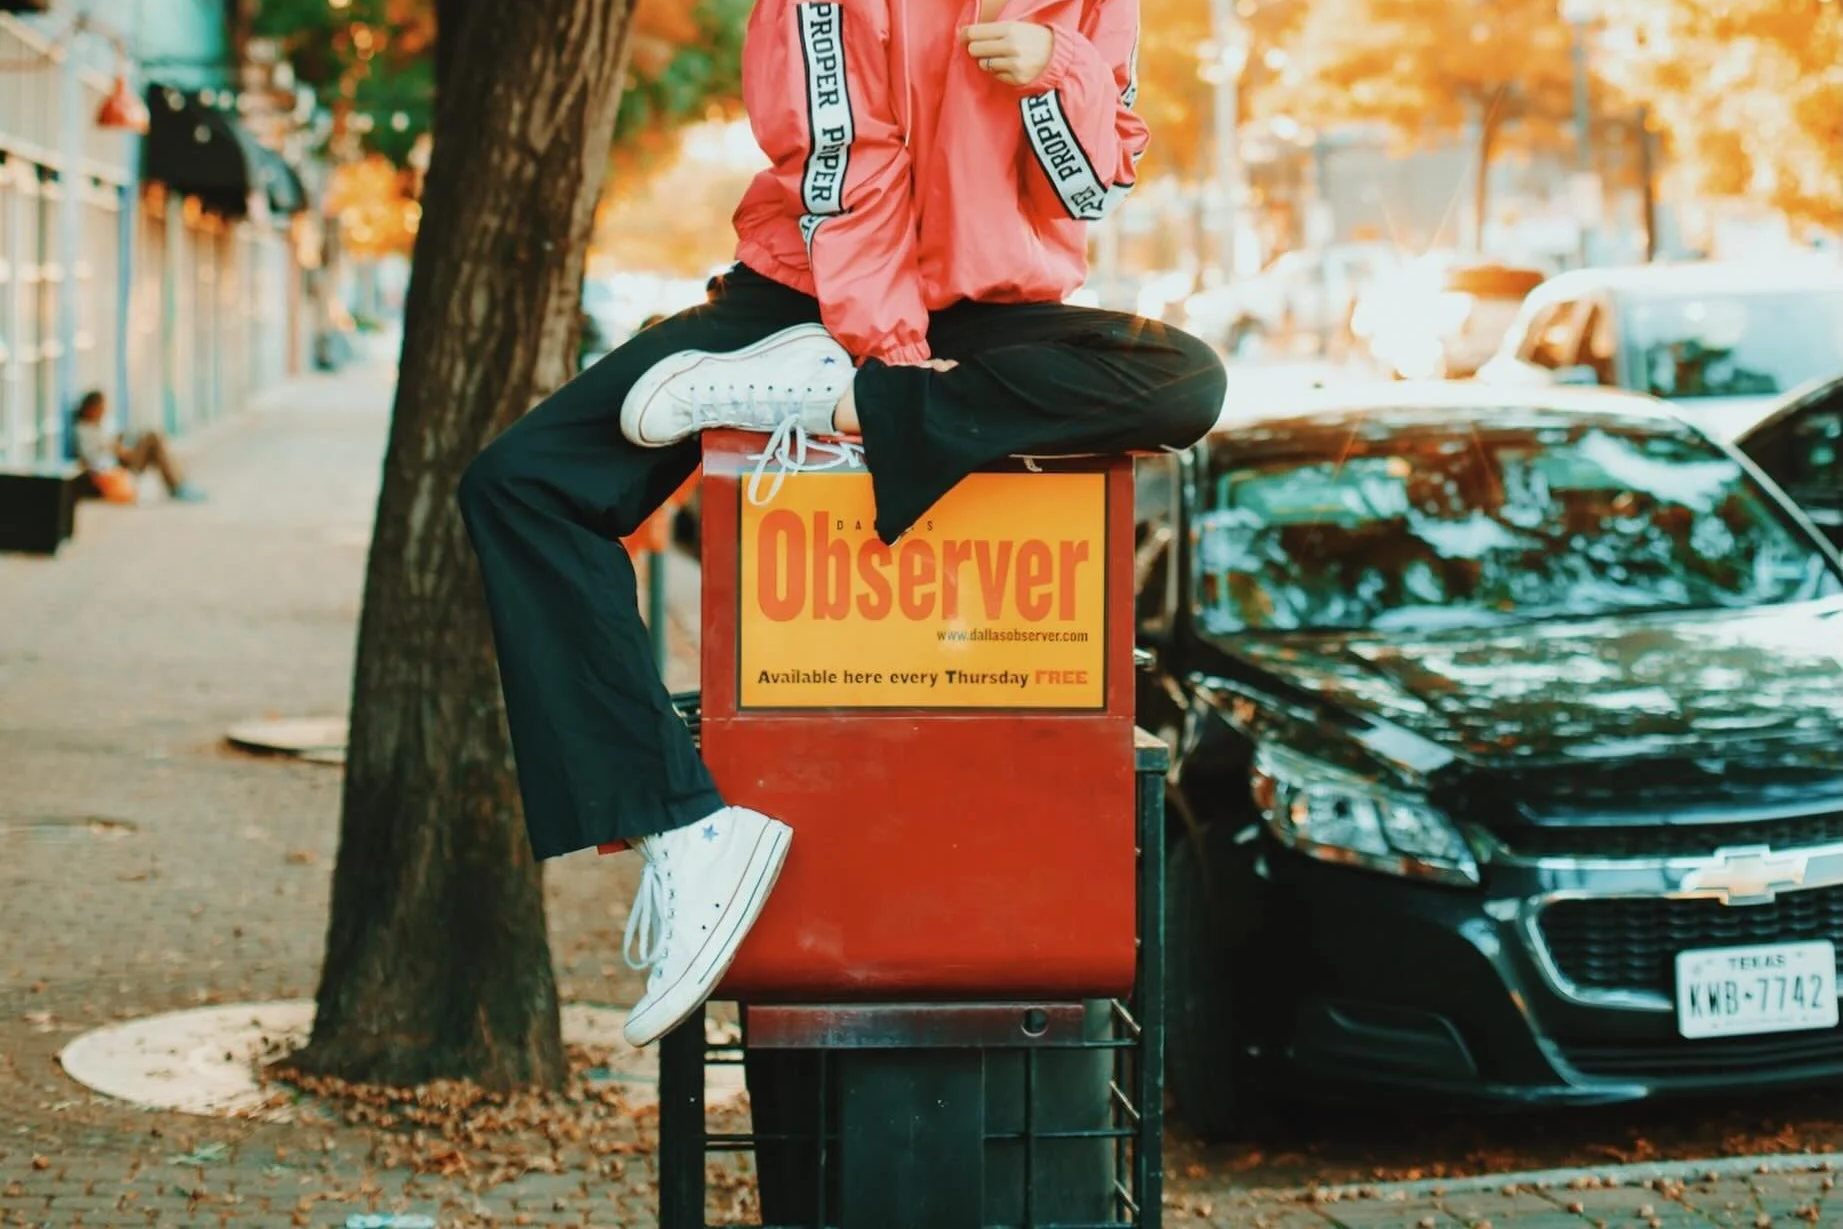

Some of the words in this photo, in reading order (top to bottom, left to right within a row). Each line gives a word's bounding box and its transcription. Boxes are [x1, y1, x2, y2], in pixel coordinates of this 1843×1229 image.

[809, 2, 840, 109] PROPER
[757, 509, 1089, 622] Observer
[936, 628, 1089, 643] www.dallasobserver.com
[758, 669, 838, 685] Available
[843, 670, 883, 685] here
[889, 672, 938, 689] every
[945, 669, 1029, 688] Thursday
[1035, 669, 1088, 685] FREE
[1728, 954, 1786, 970] TEXAS
